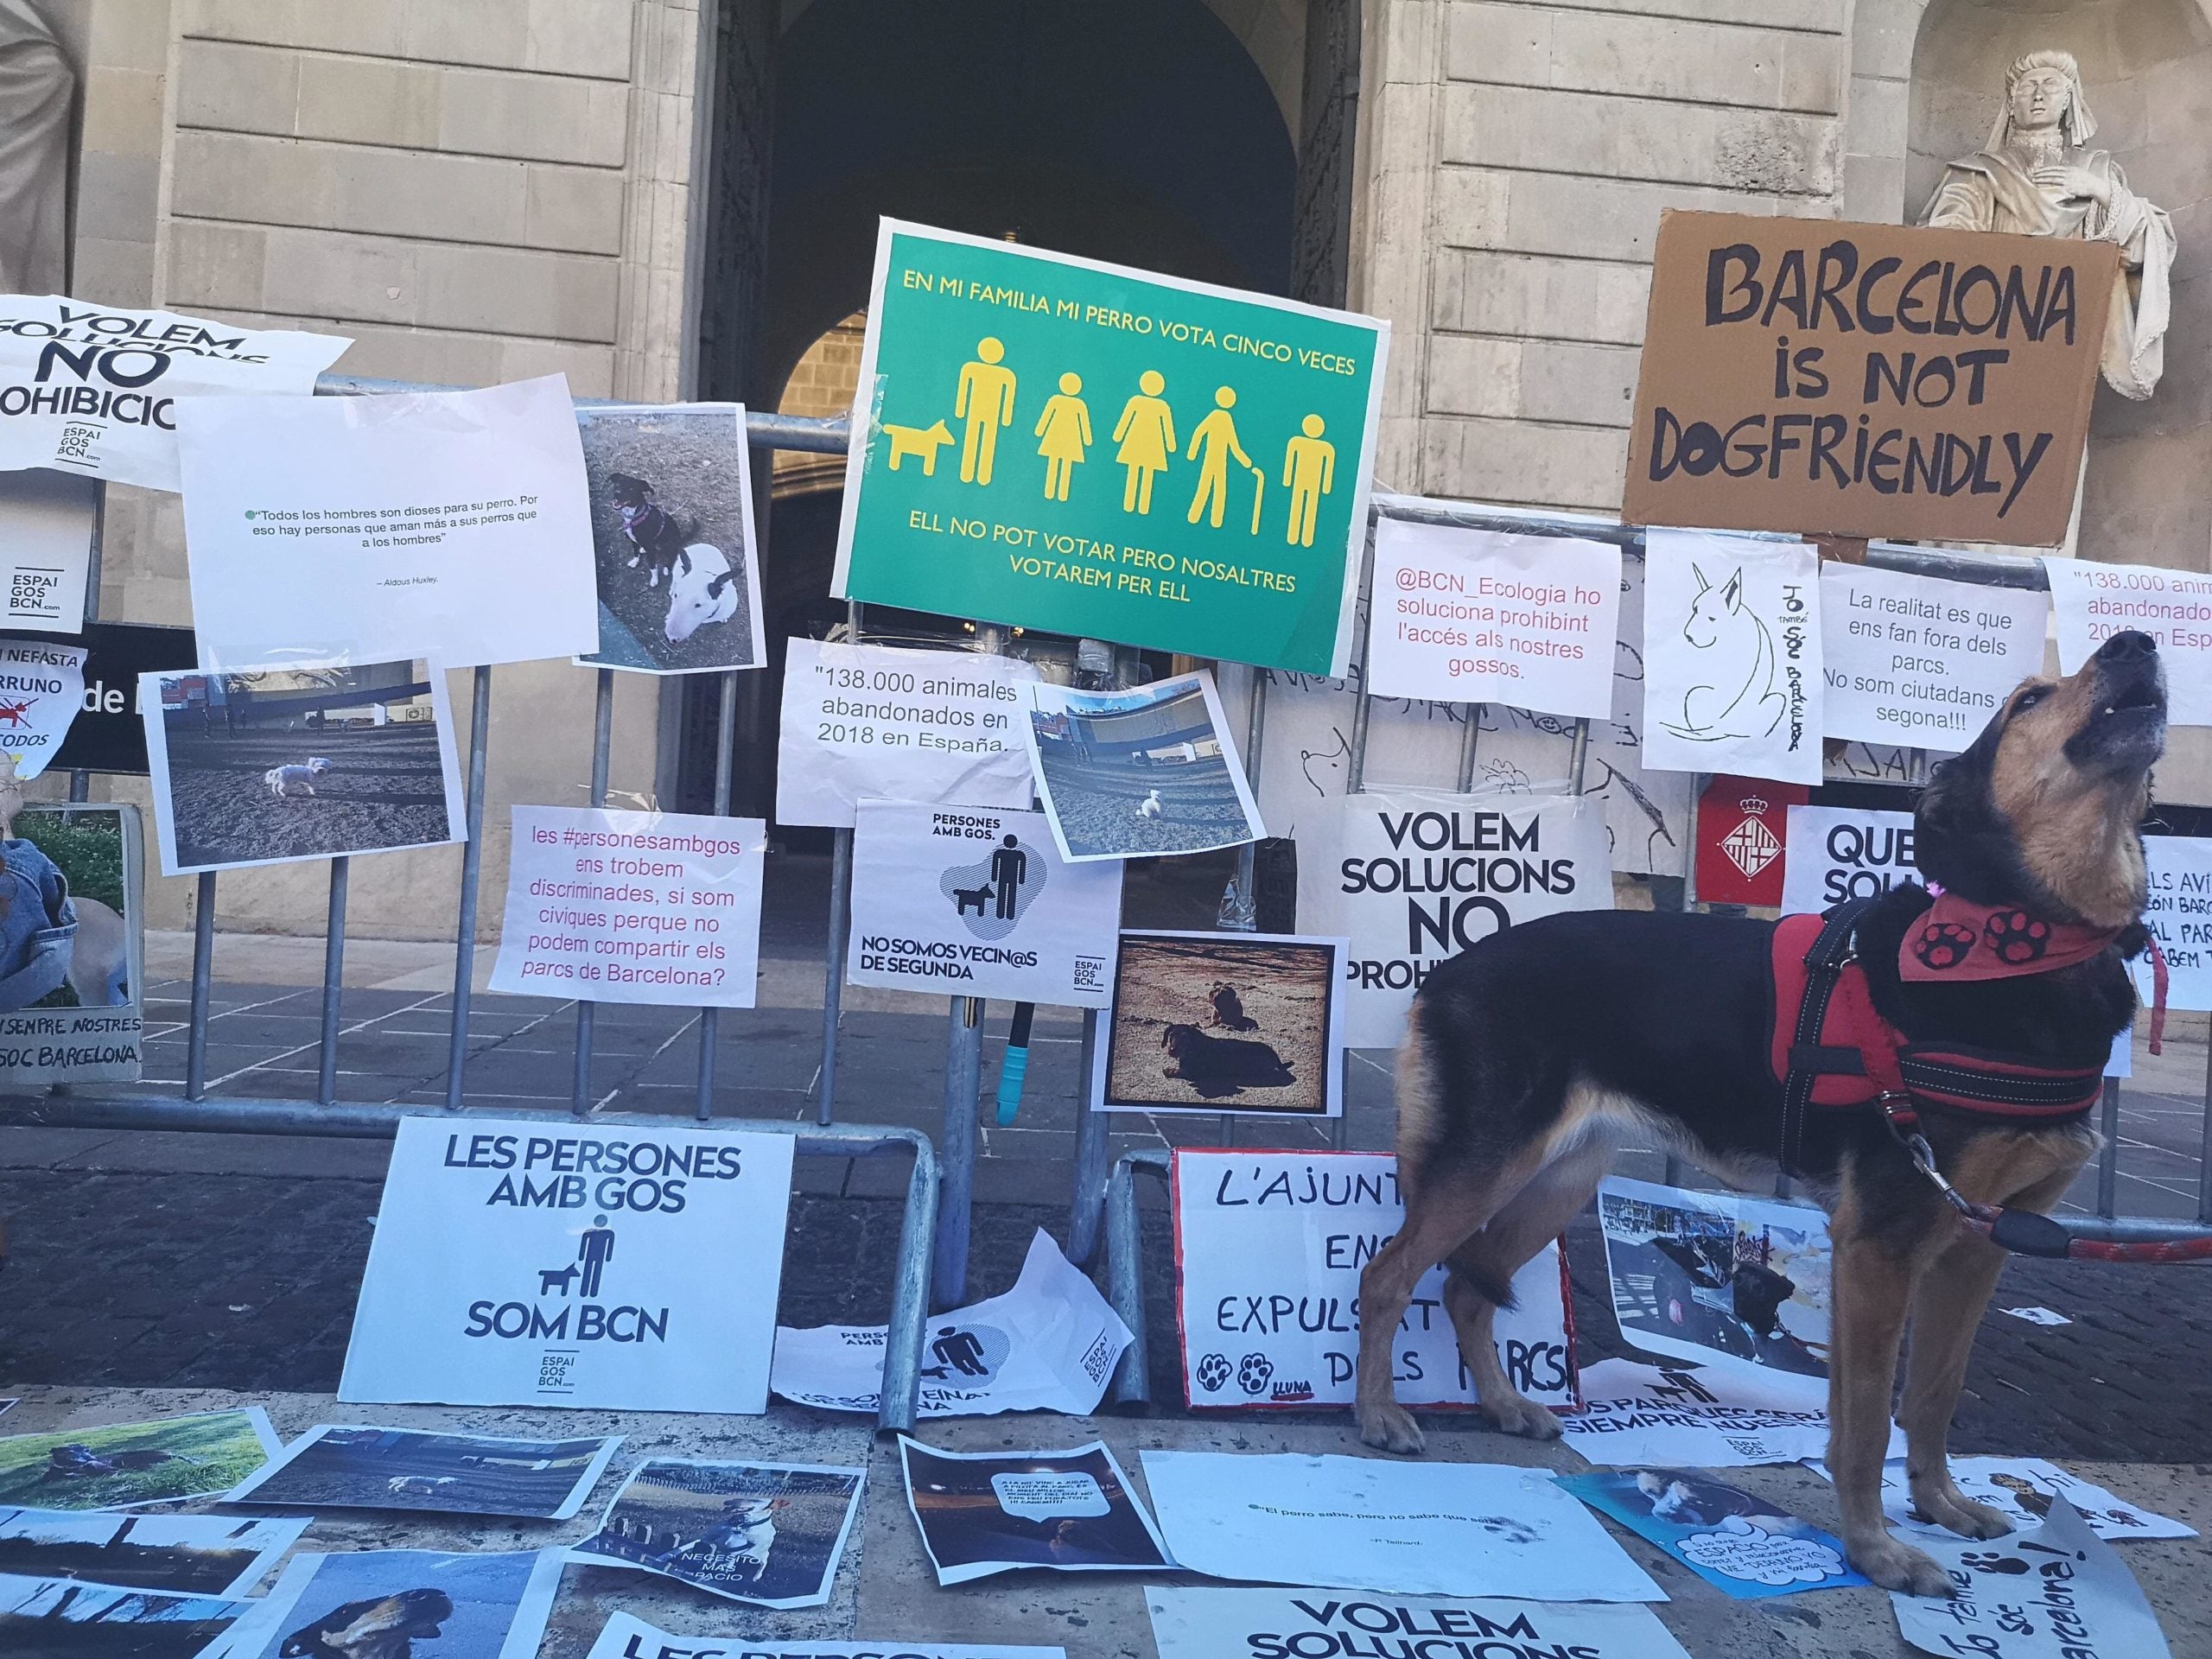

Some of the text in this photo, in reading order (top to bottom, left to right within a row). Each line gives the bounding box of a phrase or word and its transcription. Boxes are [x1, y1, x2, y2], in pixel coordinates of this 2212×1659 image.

[1705, 239, 2075, 346] BARCELONA
[59, 304, 247, 350] VOLEM
[903, 270, 1356, 377] EN MI FAMILIA MI PERRO VOTA CINCO VECES
[35, 340, 170, 388] NO
[1863, 349, 2010, 409] NOT
[60, 438, 89, 448] GOS
[63, 428, 100, 440] ESPAI
[57, 447, 101, 461] BCN.com
[302, 509, 321, 520] los
[323, 508, 378, 520] hombres
[380, 509, 401, 518] son
[404, 505, 441, 517] dioses
[443, 504, 468, 516] para
[470, 502, 484, 512] su
[486, 499, 518, 513] perro.
[520, 495, 538, 505] Por
[252, 527, 275, 536] eso
[279, 524, 301, 537] hay
[305, 524, 361, 537] personas
[364, 523, 386, 535] que
[390, 521, 421, 531] aman
[423, 517, 448, 530] más
[460, 517, 478, 526] sus
[480, 513, 515, 526] perros
[518, 510, 537, 523] que
[362, 539, 370, 548] a
[373, 536, 390, 547] los
[909, 510, 1296, 594] ELL NO POT VOTAR PERO NOSALTRES
[11, 587, 46, 598] GOS
[13, 575, 58, 588] ESPAI
[384, 578, 410, 587] Aldous
[1009, 555, 1191, 603] VOTAREM PER ELL
[1395, 568, 1601, 607] @BCN_Ecologia ho
[2074, 571, 2164, 592] "138.000
[10, 598, 60, 612] BCN.com
[1397, 598, 1589, 632] soluciona prohibint
[1849, 588, 2012, 631] La realitat es que
[1398, 622, 1584, 659] l'accés als nostres
[1849, 620, 2006, 656] ens fan fora dels
[7, 649, 78, 667] NEFASTA
[1448, 658, 1525, 679] gossos.
[1891, 654, 1949, 676] parcs.
[82, 681, 124, 714] de
[816, 666, 1017, 702] "138.000 animales
[1823, 667, 1847, 689] No
[1854, 677, 1894, 695] som
[1901, 680, 1995, 709] ciutadans
[822, 697, 1007, 729] abandonados en
[1876, 706, 1966, 730] segona!!!
[817, 723, 1008, 753] 2018 en España.
[932, 814, 1001, 830] PERSONES
[932, 825, 995, 841] AMB GOS.
[1378, 811, 1540, 852] VOLEM
[532, 826, 741, 858] les #personesambgos
[576, 857, 683, 878] ens trobem
[1341, 857, 1575, 894] SOLUCIONS
[530, 879, 734, 906] discriminades, si som
[613, 913, 687, 934] perque
[694, 918, 720, 932] no
[1408, 896, 1511, 955] NO
[528, 933, 726, 960] podem compartir els
[862, 936, 1038, 969] NO SOMOS VECIN@S
[521, 960, 726, 987] parcs de Barcelona?
[861, 955, 974, 980] DE SEGUNDA
[1074, 969, 1096, 978] GOS
[1075, 961, 1102, 971] ESPAI
[5, 1018, 142, 1035] SEMPRE NOSTRES
[444, 1134, 741, 1180] LES PERSONES
[486, 1174, 686, 1214] AMB GOS
[464, 1300, 669, 1343] SOM BCN
[540, 1367, 566, 1377] GOS
[542, 1356, 575, 1368] ESPAI
[681, 1553, 761, 1565] NECESITO
[1290, 1599, 1541, 1640] VOLEM
